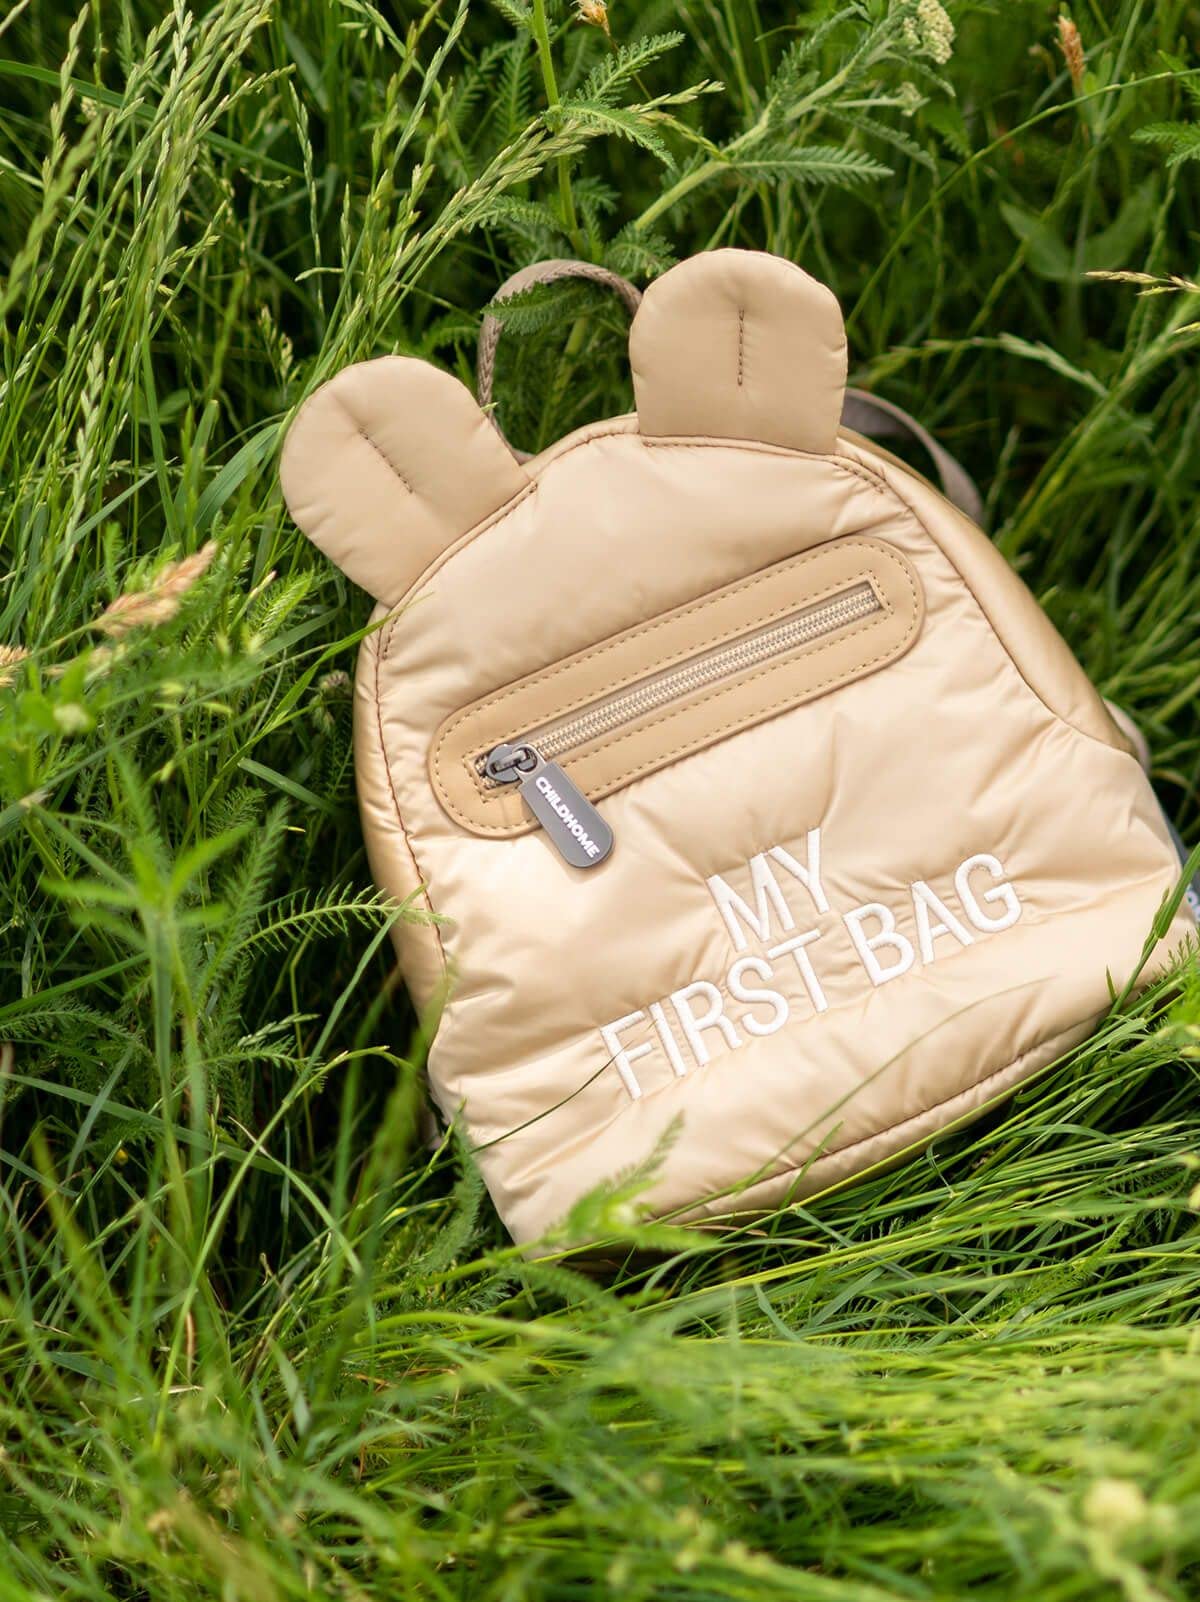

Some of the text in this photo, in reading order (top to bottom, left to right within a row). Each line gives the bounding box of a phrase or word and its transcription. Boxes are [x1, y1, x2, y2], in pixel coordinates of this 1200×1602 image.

[535, 776, 600, 858] CHILDHOME
[705, 827, 830, 952] MY
[599, 853, 1023, 1100] FIRST BAG
